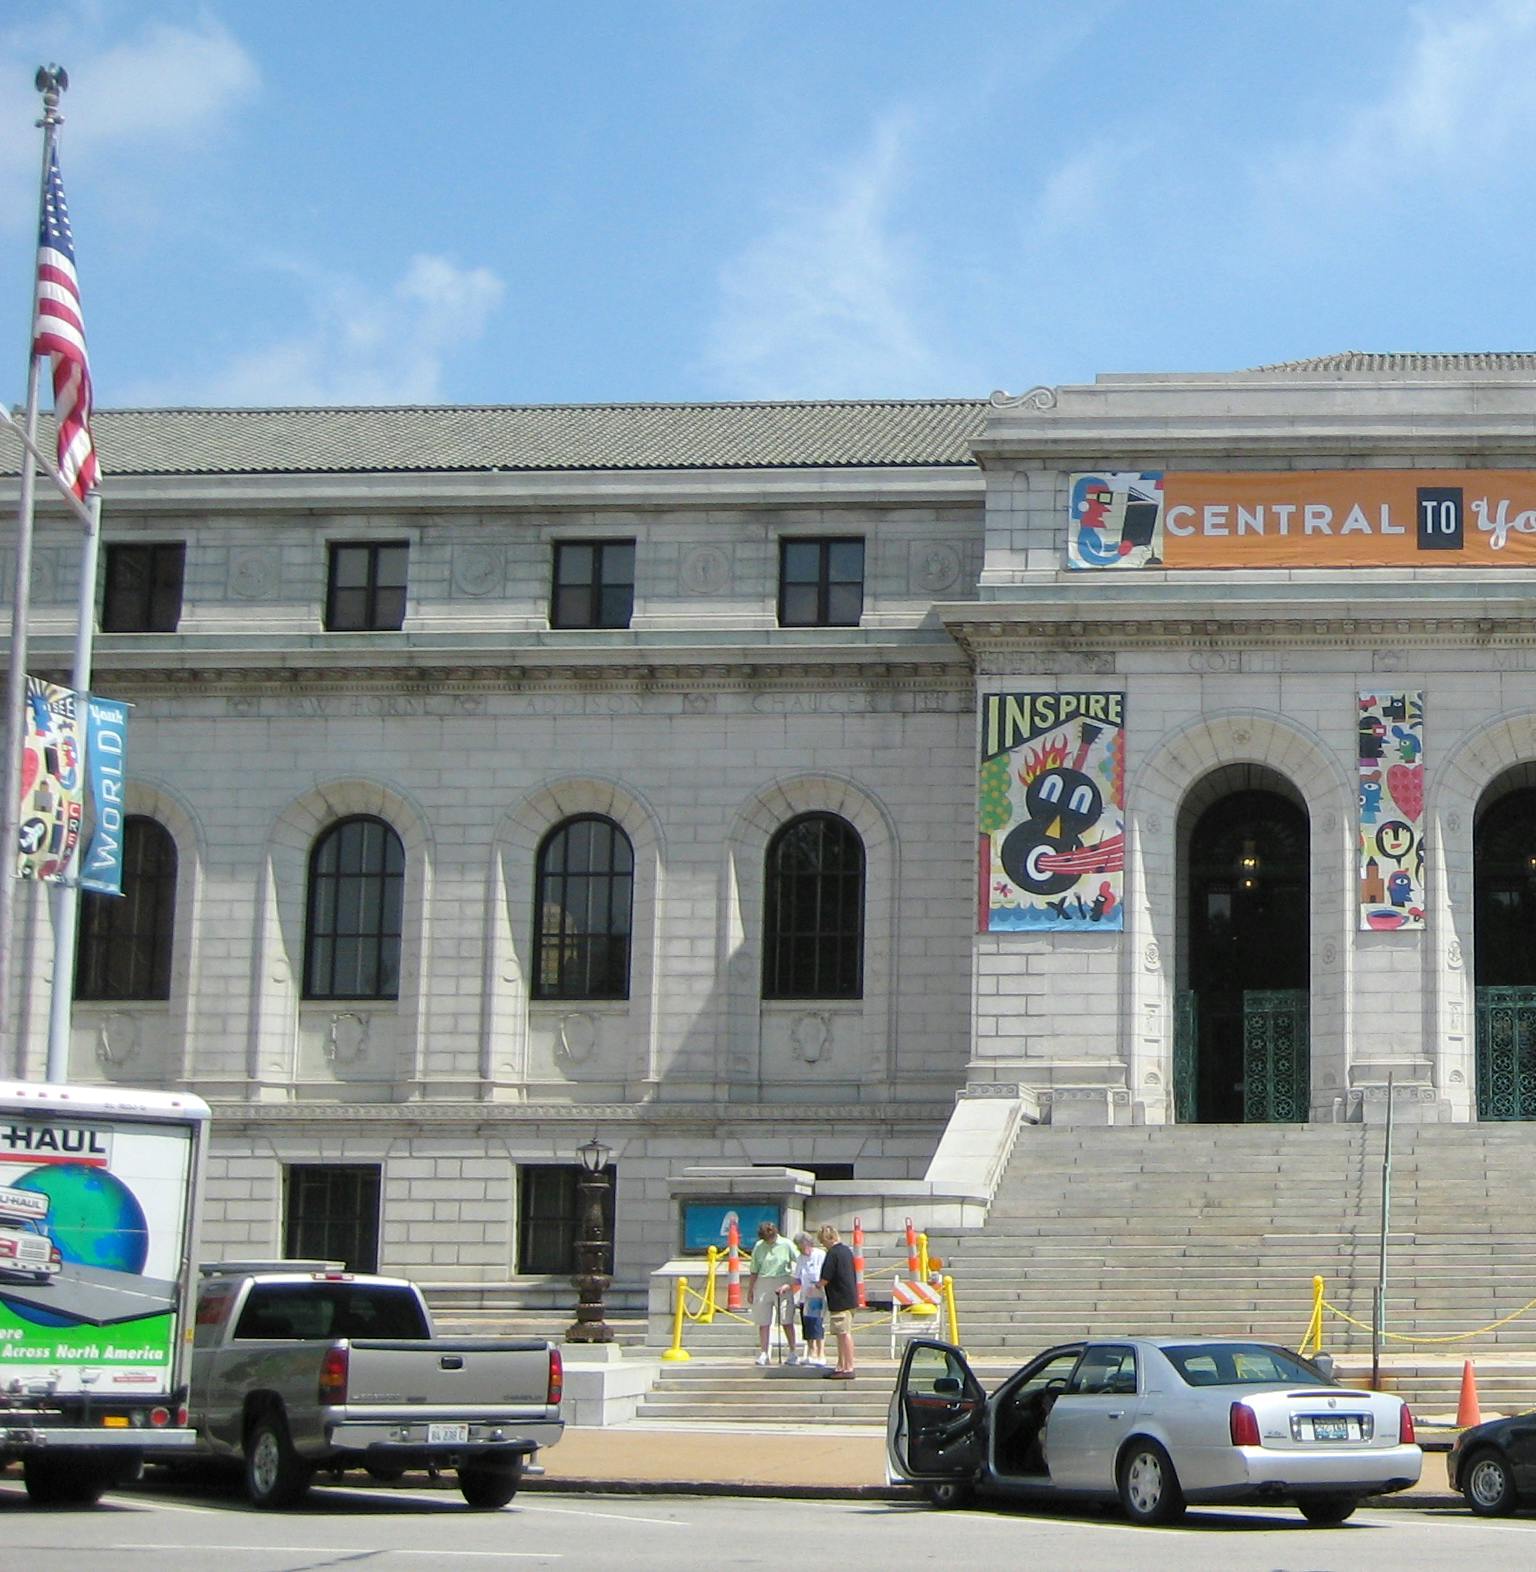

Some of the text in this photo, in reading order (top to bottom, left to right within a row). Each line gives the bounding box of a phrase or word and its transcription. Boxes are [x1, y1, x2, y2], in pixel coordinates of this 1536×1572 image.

[1166, 504, 1405, 536] CENTRAL
[1422, 500, 1456, 534] TO
[988, 694, 1122, 756] INSPIRE
[92, 730, 123, 870] WORLD
[1, 1126, 106, 1153] -HAUL
[2, 1344, 163, 1360] Across North America
